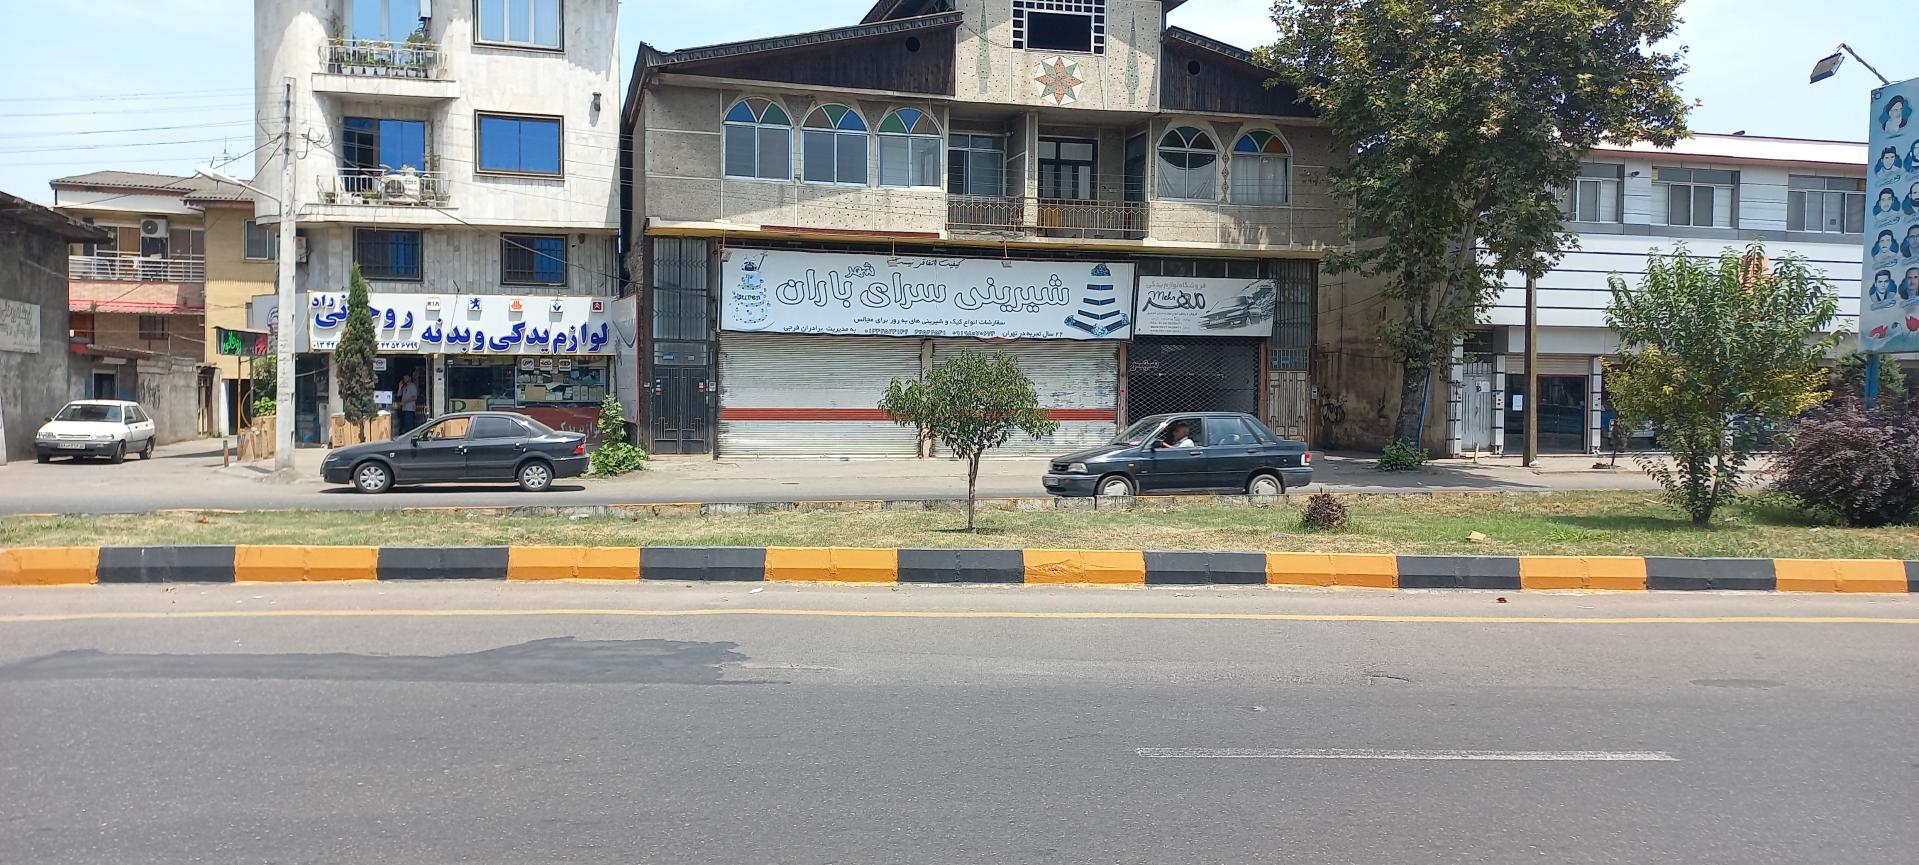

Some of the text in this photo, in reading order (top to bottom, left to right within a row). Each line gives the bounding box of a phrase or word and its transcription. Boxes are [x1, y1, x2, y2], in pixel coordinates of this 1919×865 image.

[775, 262, 1070, 313] شیرینی سرای شهر باران
[1147, 290, 1176, 300] Mehr
[1141, 289, 1206, 312] مهر
[315, 294, 413, 329] روحنی
[853, 316, 874, 324] مجالس
[875, 316, 889, 324] برای
[889, 317, 900, 325] روز
[921, 318, 944, 326] شیرینی
[949, 318, 963, 326] کیک
[963, 319, 978, 328] انواع
[978, 319, 1006, 327] سفارشات
[488, 321, 550, 352] یدکی
[552, 321, 609, 353] لوازم
